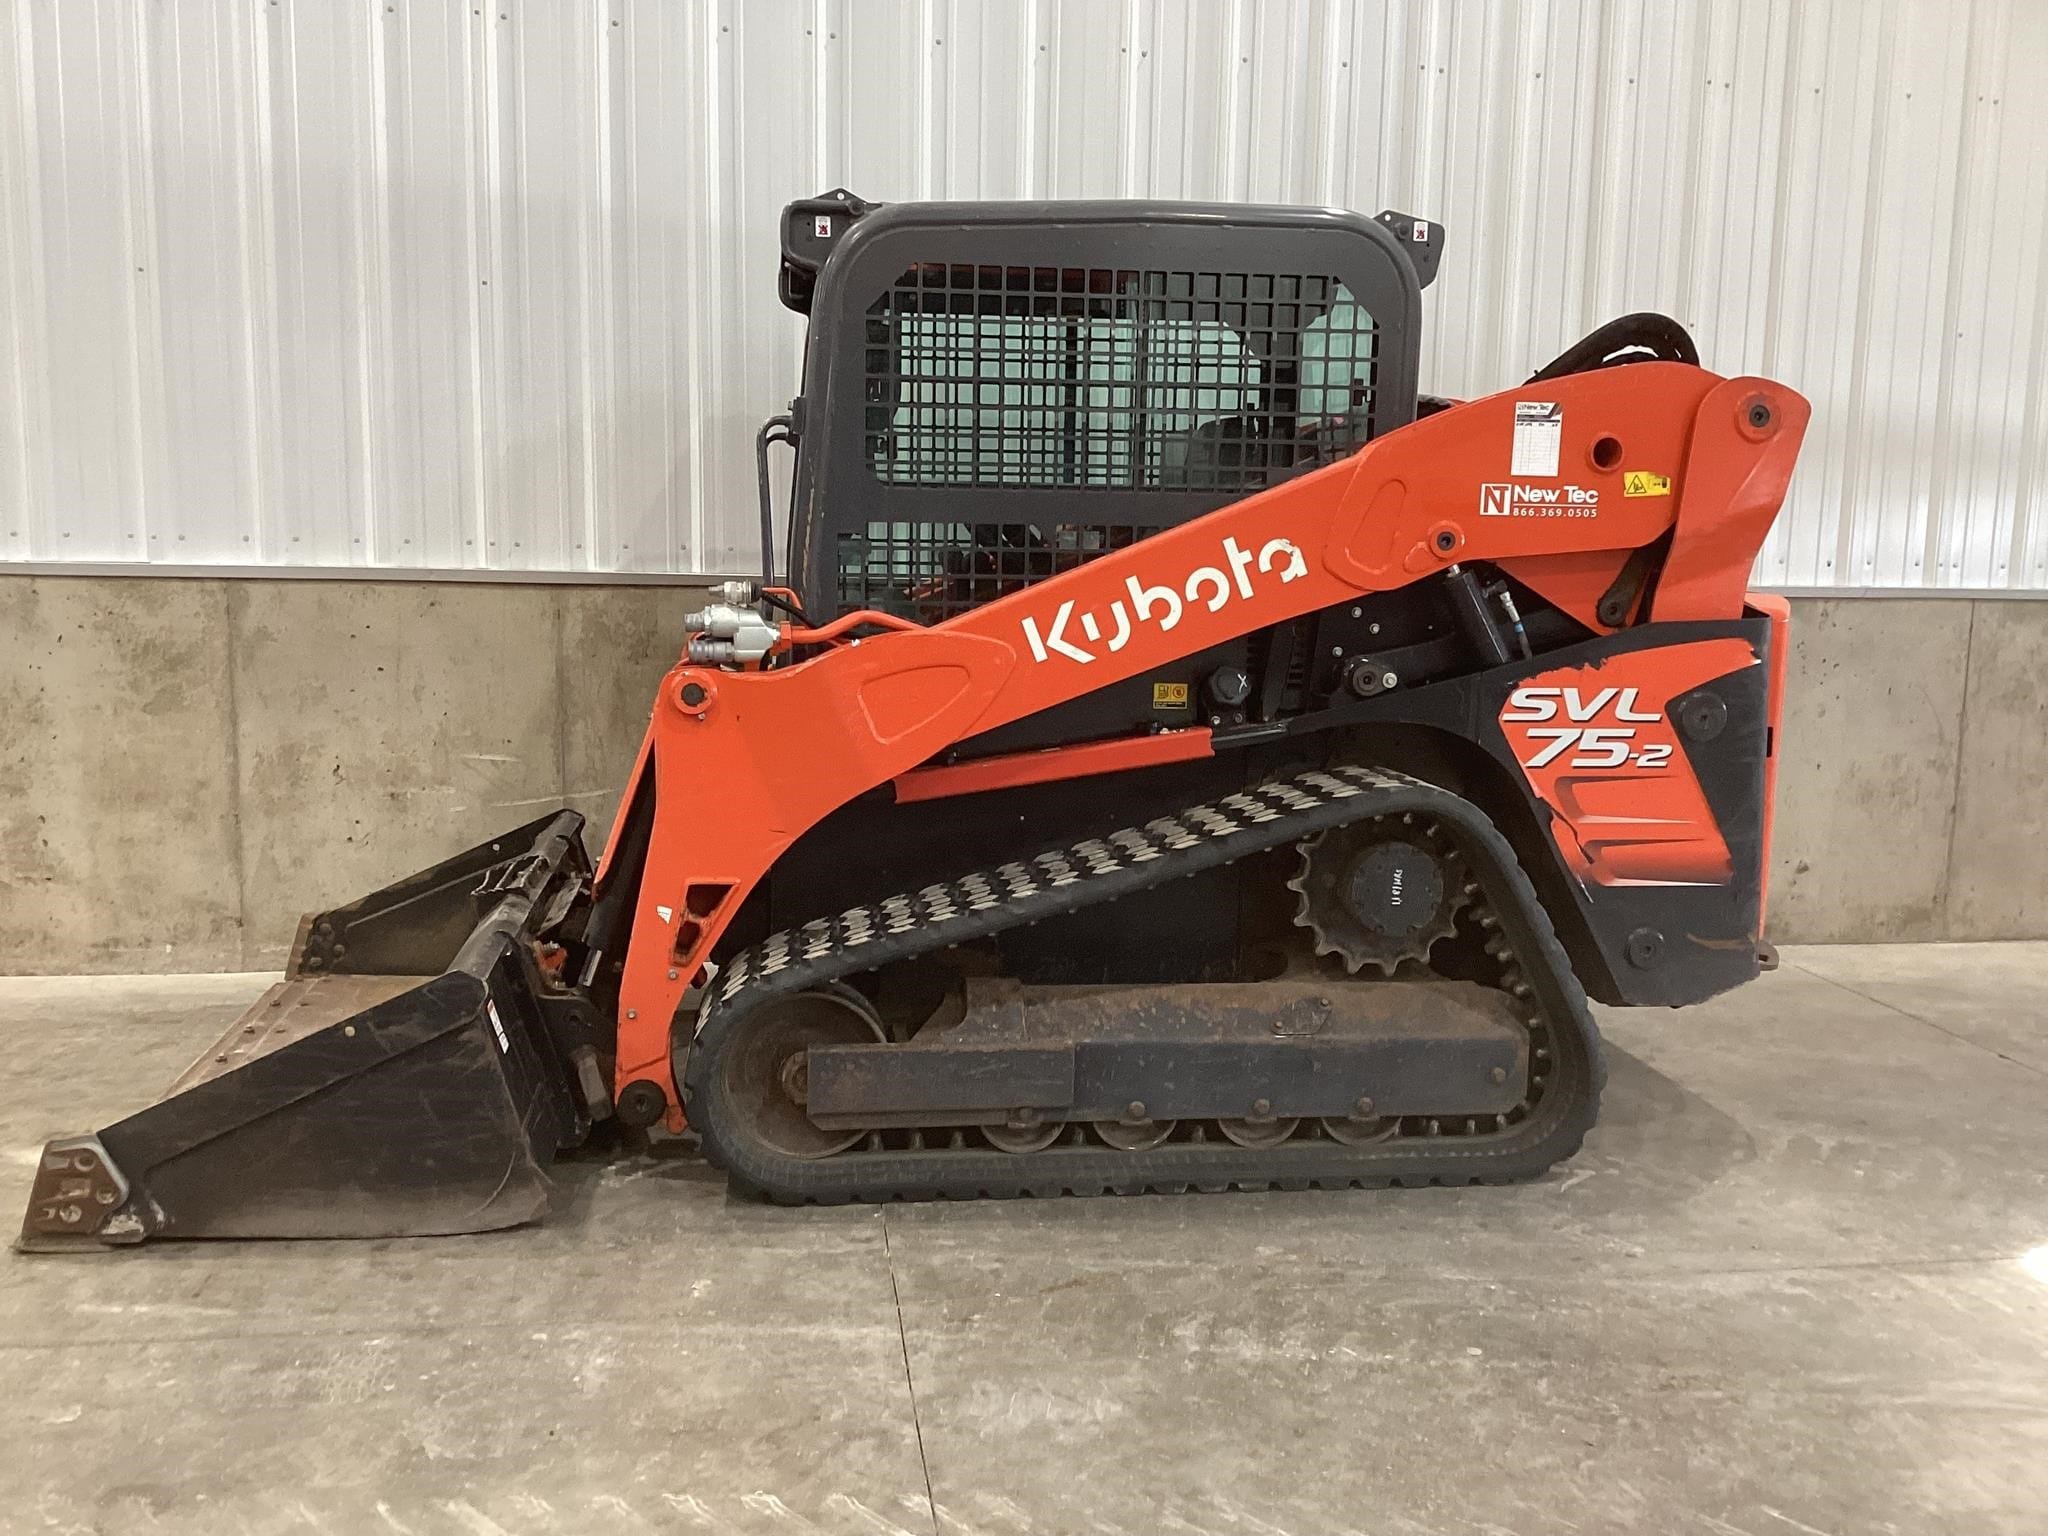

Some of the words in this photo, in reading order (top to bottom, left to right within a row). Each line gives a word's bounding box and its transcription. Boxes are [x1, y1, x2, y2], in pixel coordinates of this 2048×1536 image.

[1513, 485, 1561, 503] New
[1563, 485, 1599, 503] Tec
[1513, 507, 1597, 518] 866.369.0505
[1021, 536, 1308, 664] Kubota
[1501, 688, 1663, 722] SVL
[1524, 728, 1673, 768] 75-2
